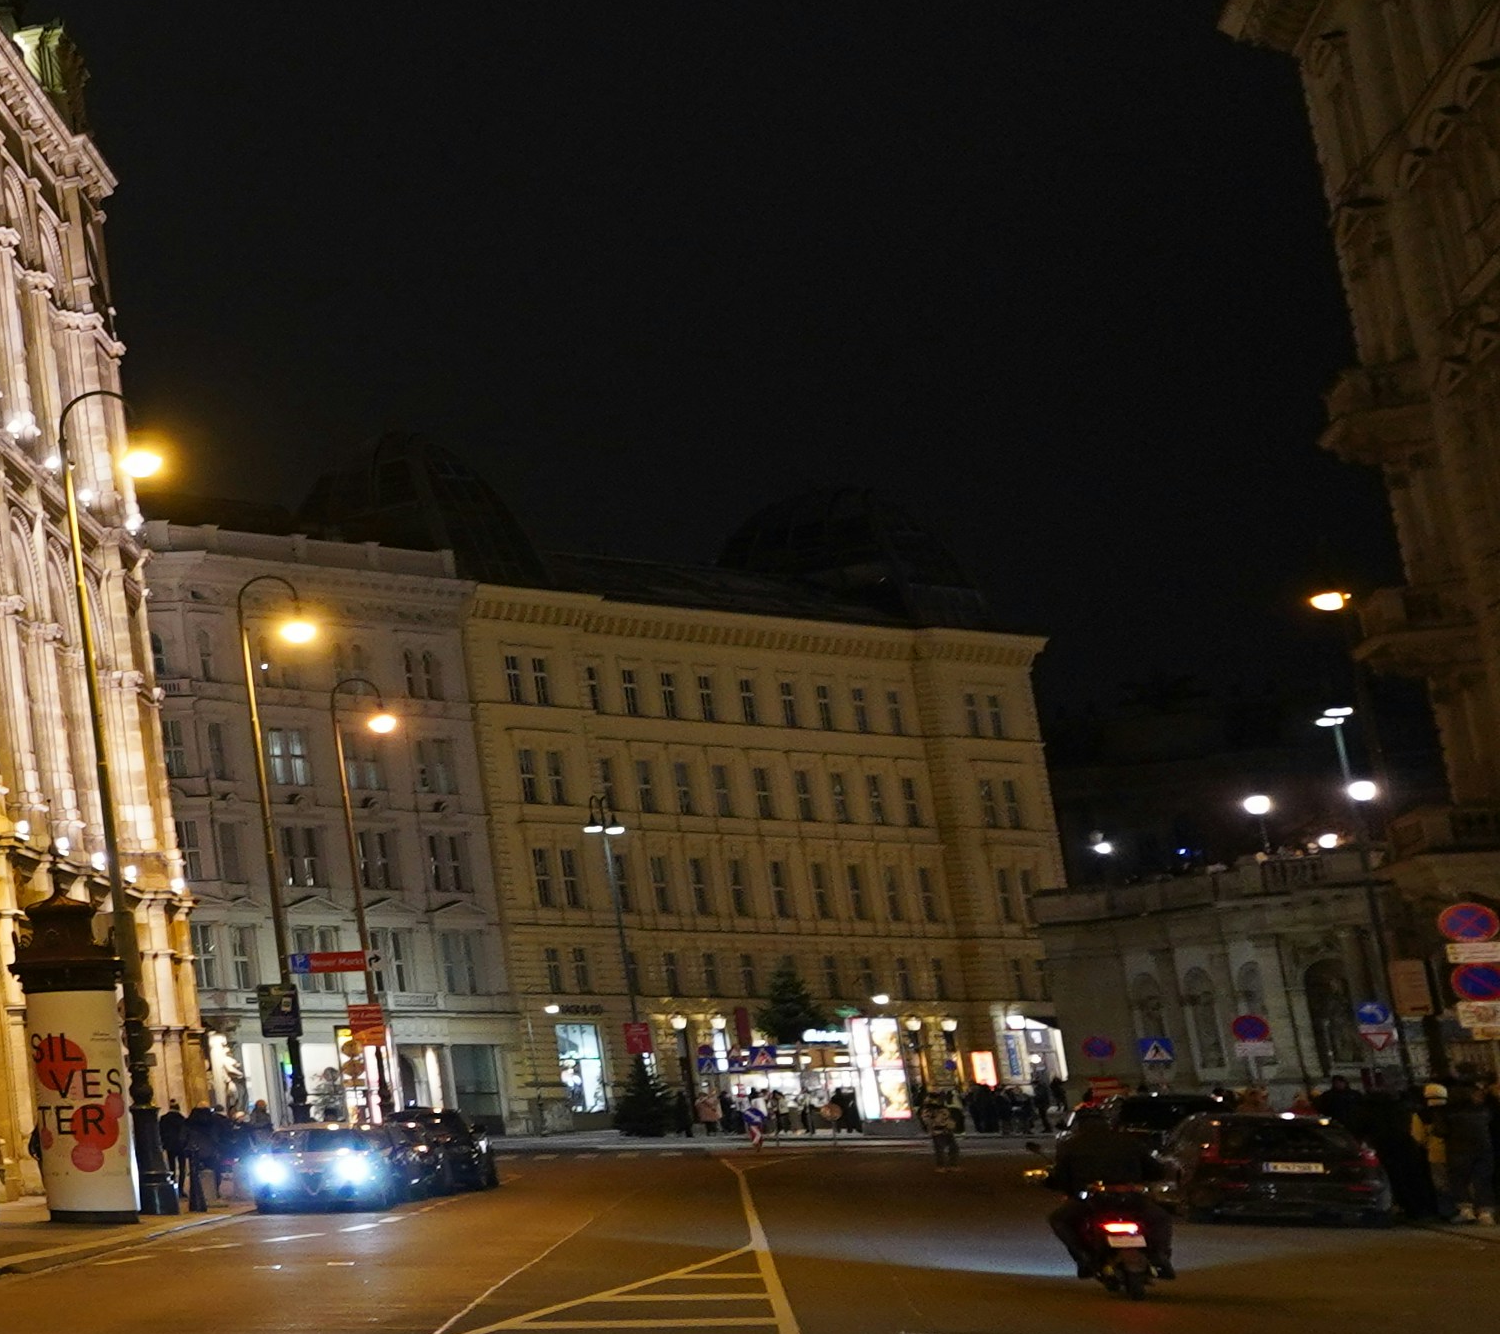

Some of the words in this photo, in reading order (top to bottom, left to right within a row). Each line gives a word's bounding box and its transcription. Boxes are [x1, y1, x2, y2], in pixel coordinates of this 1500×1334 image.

[31, 1033, 83, 1063] SIL
[49, 1068, 123, 1098] VES
[37, 1105, 106, 1135] TER
